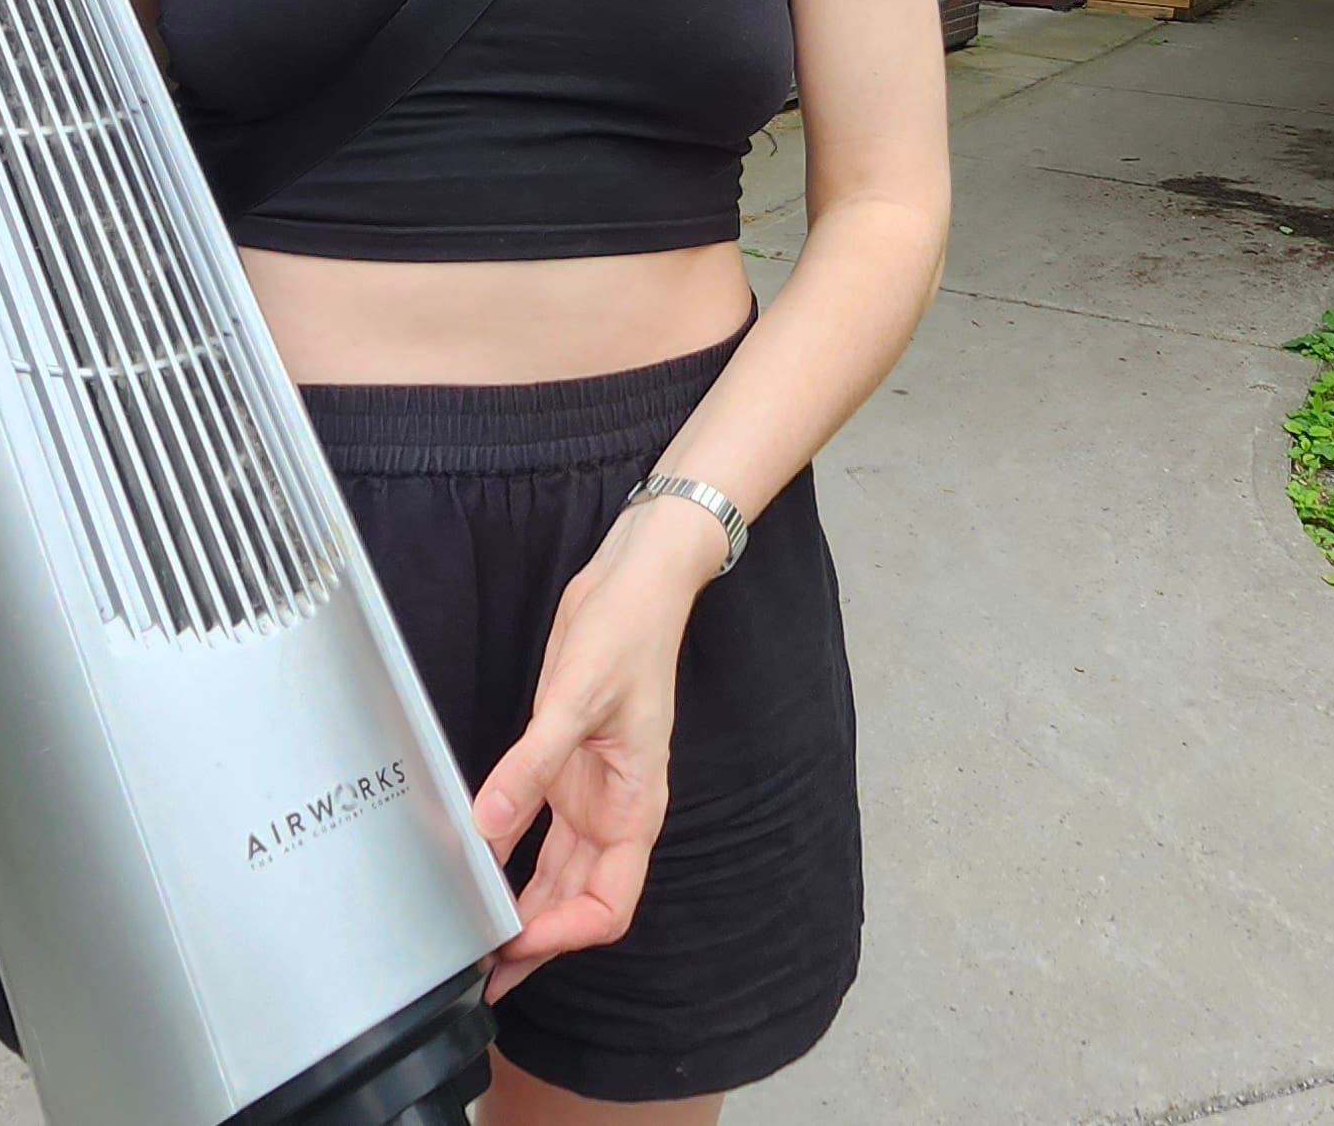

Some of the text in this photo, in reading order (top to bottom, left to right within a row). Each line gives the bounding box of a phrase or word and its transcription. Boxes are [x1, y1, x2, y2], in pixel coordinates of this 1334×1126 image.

[248, 761, 405, 861] AIRWORKS
[283, 839, 303, 854] AIR
[371, 786, 410, 810] COMPANY
